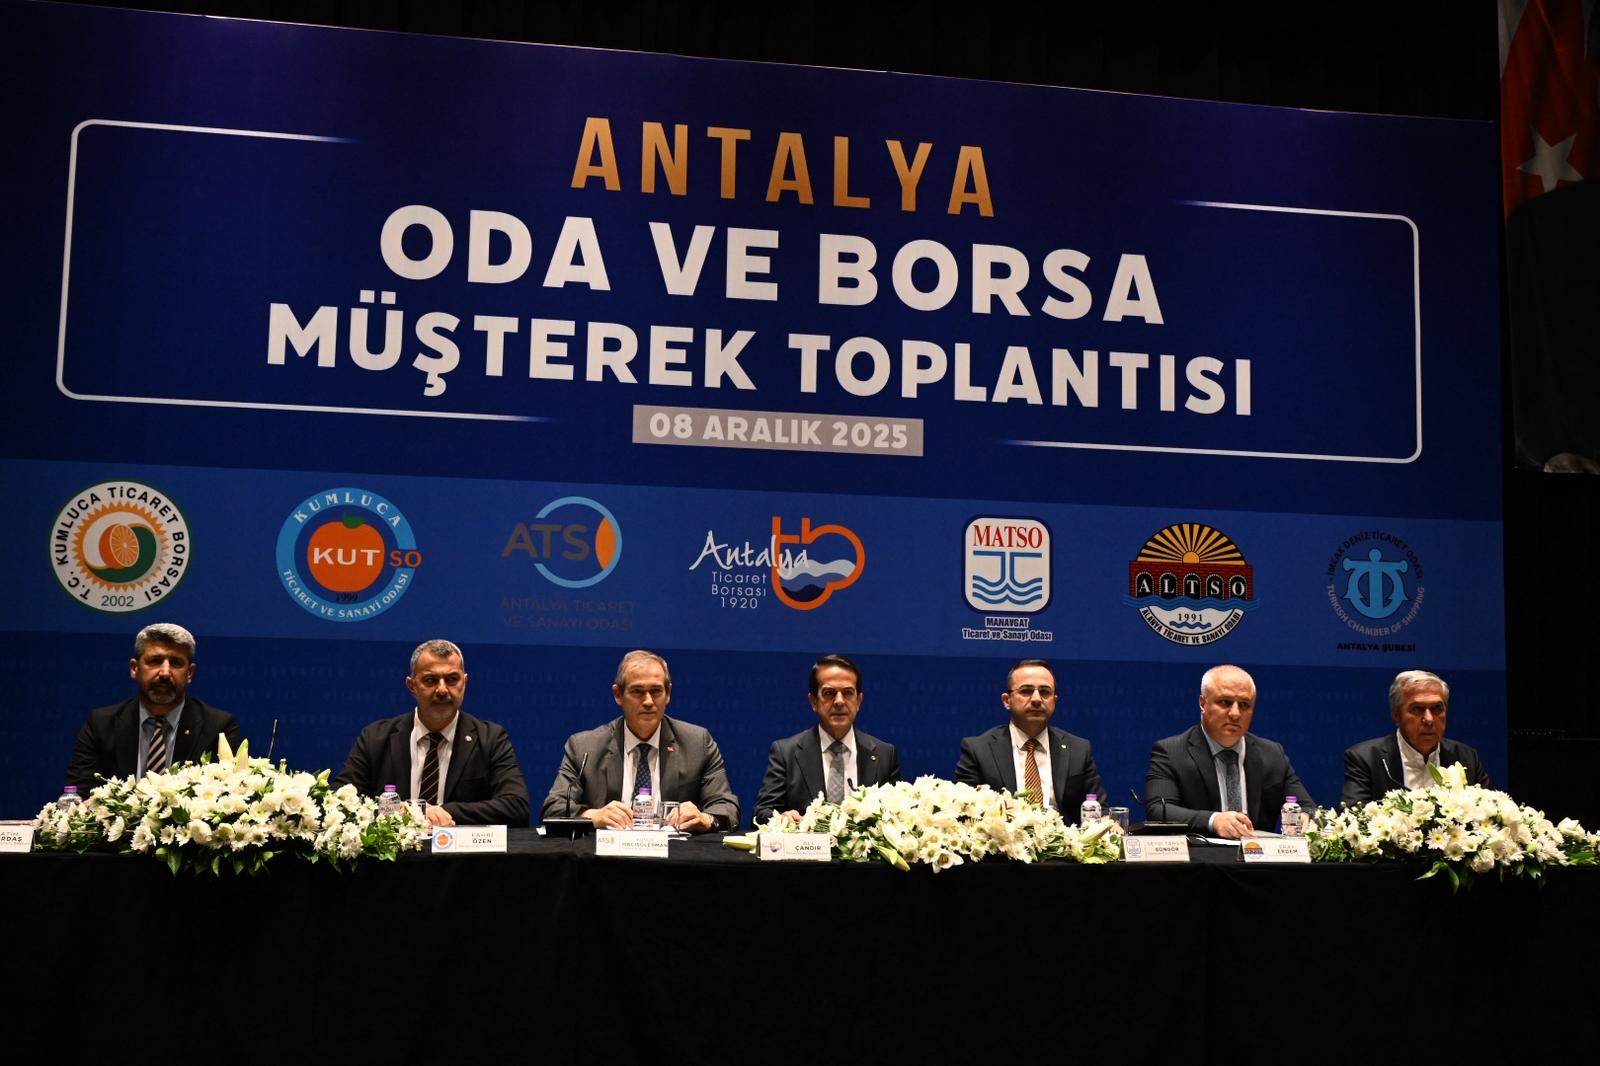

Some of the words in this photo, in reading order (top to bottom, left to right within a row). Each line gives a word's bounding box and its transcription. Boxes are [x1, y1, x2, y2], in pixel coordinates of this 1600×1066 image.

[570, 117, 994, 217] ANTALYA
[380, 205, 611, 291] ODA
[648, 221, 779, 302] VE
[818, 233, 1164, 324] BORSA
[267, 289, 757, 397] MÜŞTEREK
[788, 332, 1251, 416] TOPLANTISI
[649, 412, 693, 440] 08
[702, 415, 822, 446] ARALIK
[831, 420, 908, 449] 2025
[293, 491, 401, 528] KUMLUCA
[55, 492, 101, 566] KUMLUCA
[972, 524, 1043, 549] MATSO
[145, 531, 186, 601] BORSASI
[689, 530, 810, 580] Antalya
[67, 571, 92, 600] T.C.
[283, 569, 318, 609] TİCARET
[320, 605, 336, 617] VE
[337, 600, 382, 619] SANAYİ
[381, 572, 409, 605] ODASI
[711, 571, 767, 584] Ticaret
[711, 584, 767, 597] Borsası
[1139, 578, 1246, 597] ALTSO
[101, 595, 135, 607] 2002
[720, 596, 758, 609] 1920
[1178, 613, 1203, 622] 1991
[1347, 619, 1391, 637] CHAMBER
[1390, 621, 1403, 633] OF
[1401, 585, 1426, 626] SHIPPING
[962, 627, 990, 640] Ticaret
[991, 630, 1001, 639] ve
[1003, 629, 1029, 642] Sanayi
[1030, 630, 1053, 642] Odası
[985, 617, 1029, 629] MANAVGAT
[1141, 608, 1163, 633] ALANYA
[1191, 636, 1201, 645] VE
[1223, 611, 1241, 631] ODASI
[1336, 642, 1380, 651] ANTALYA
